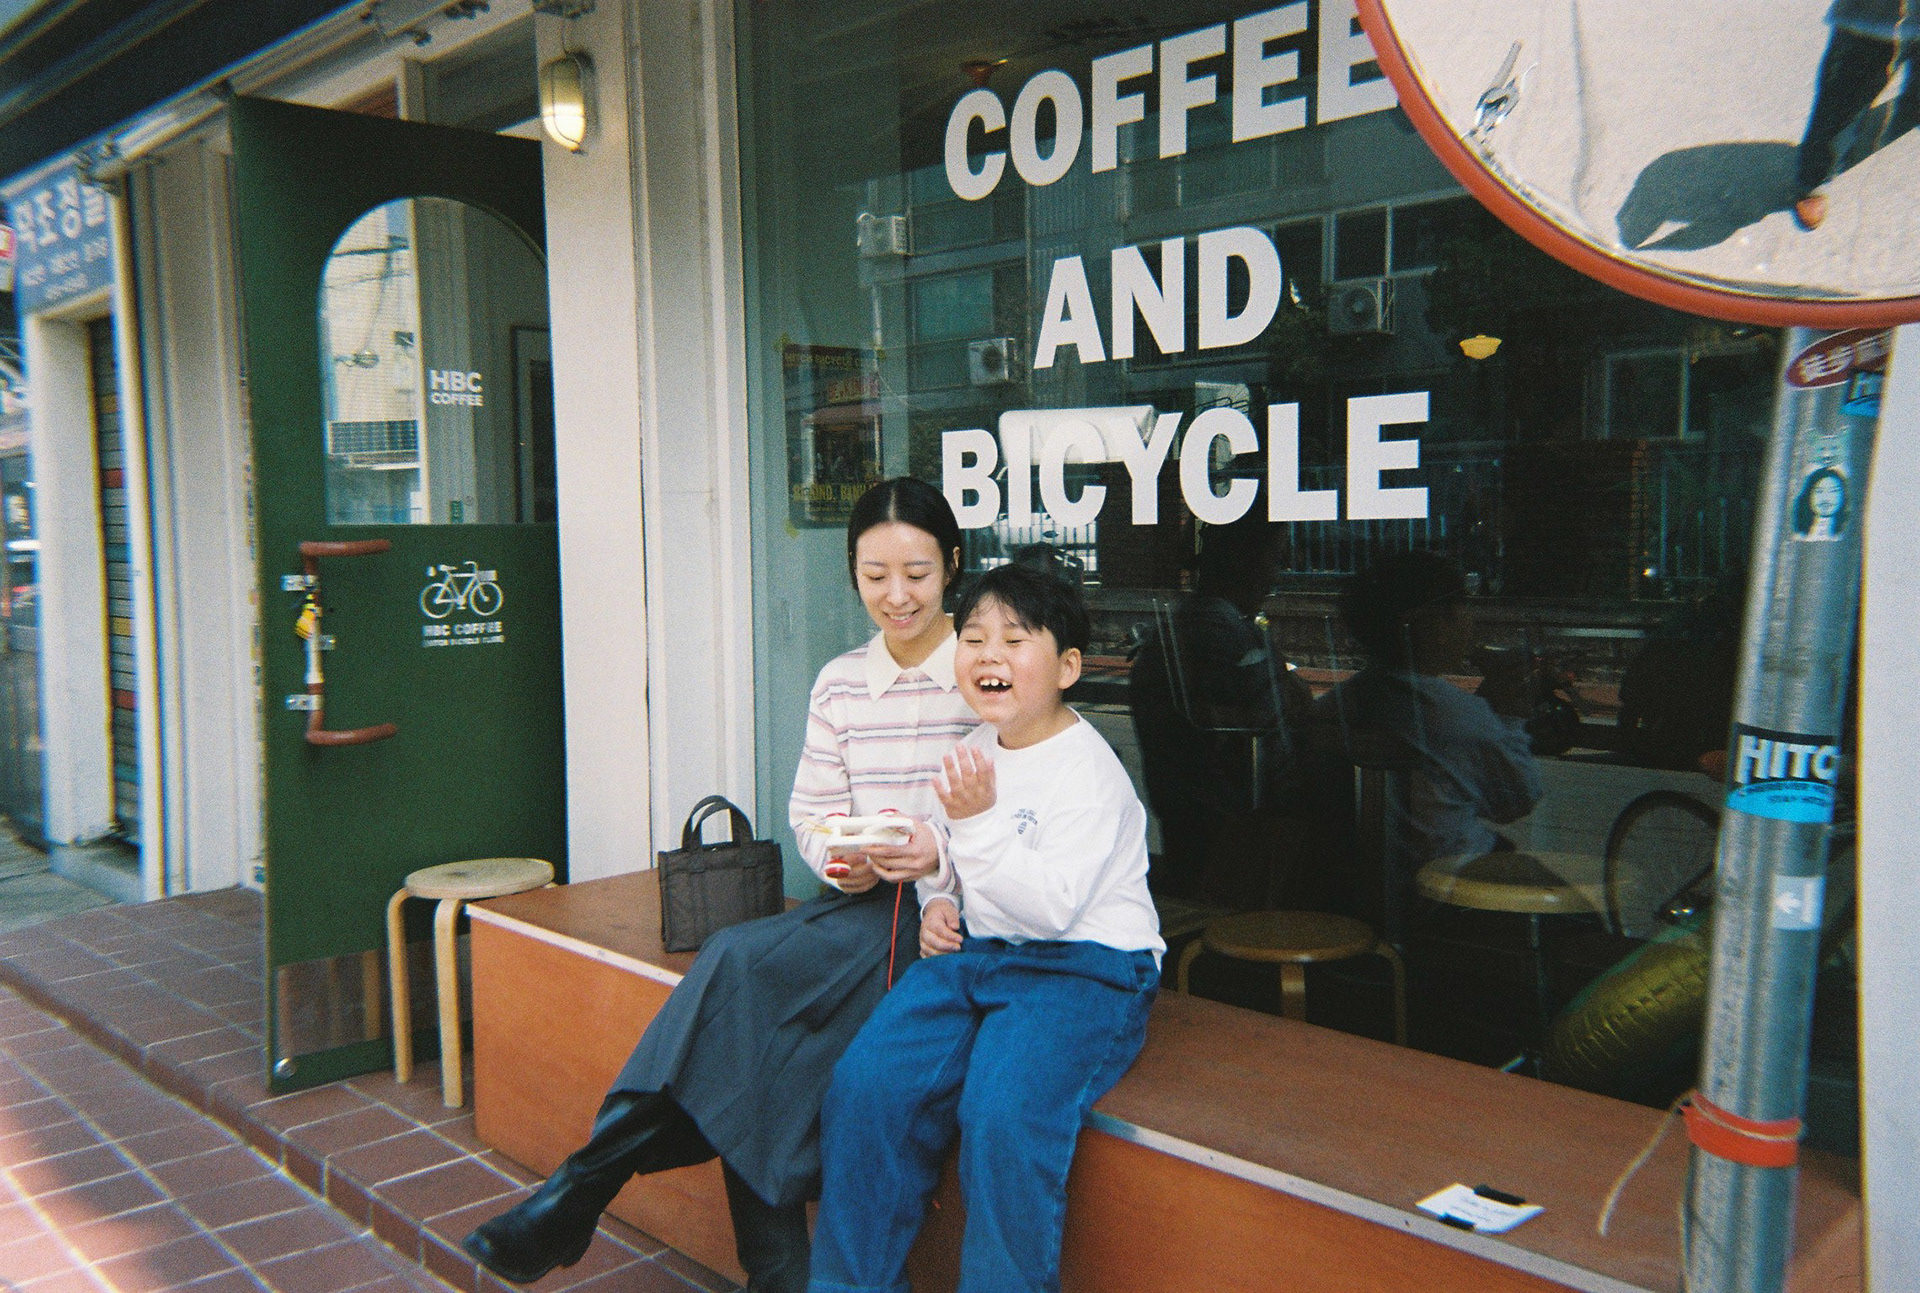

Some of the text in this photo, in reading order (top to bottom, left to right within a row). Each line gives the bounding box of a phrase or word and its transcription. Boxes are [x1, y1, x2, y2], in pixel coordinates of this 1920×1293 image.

[944, 0, 1398, 201] COFFEE
[1034, 226, 1282, 369] AND
[430, 369, 483, 393] HBC
[431, 392, 484, 407] COFFEE
[941, 391, 1430, 529] BICYCLE
[423, 621, 503, 636] HBC COFFEE
